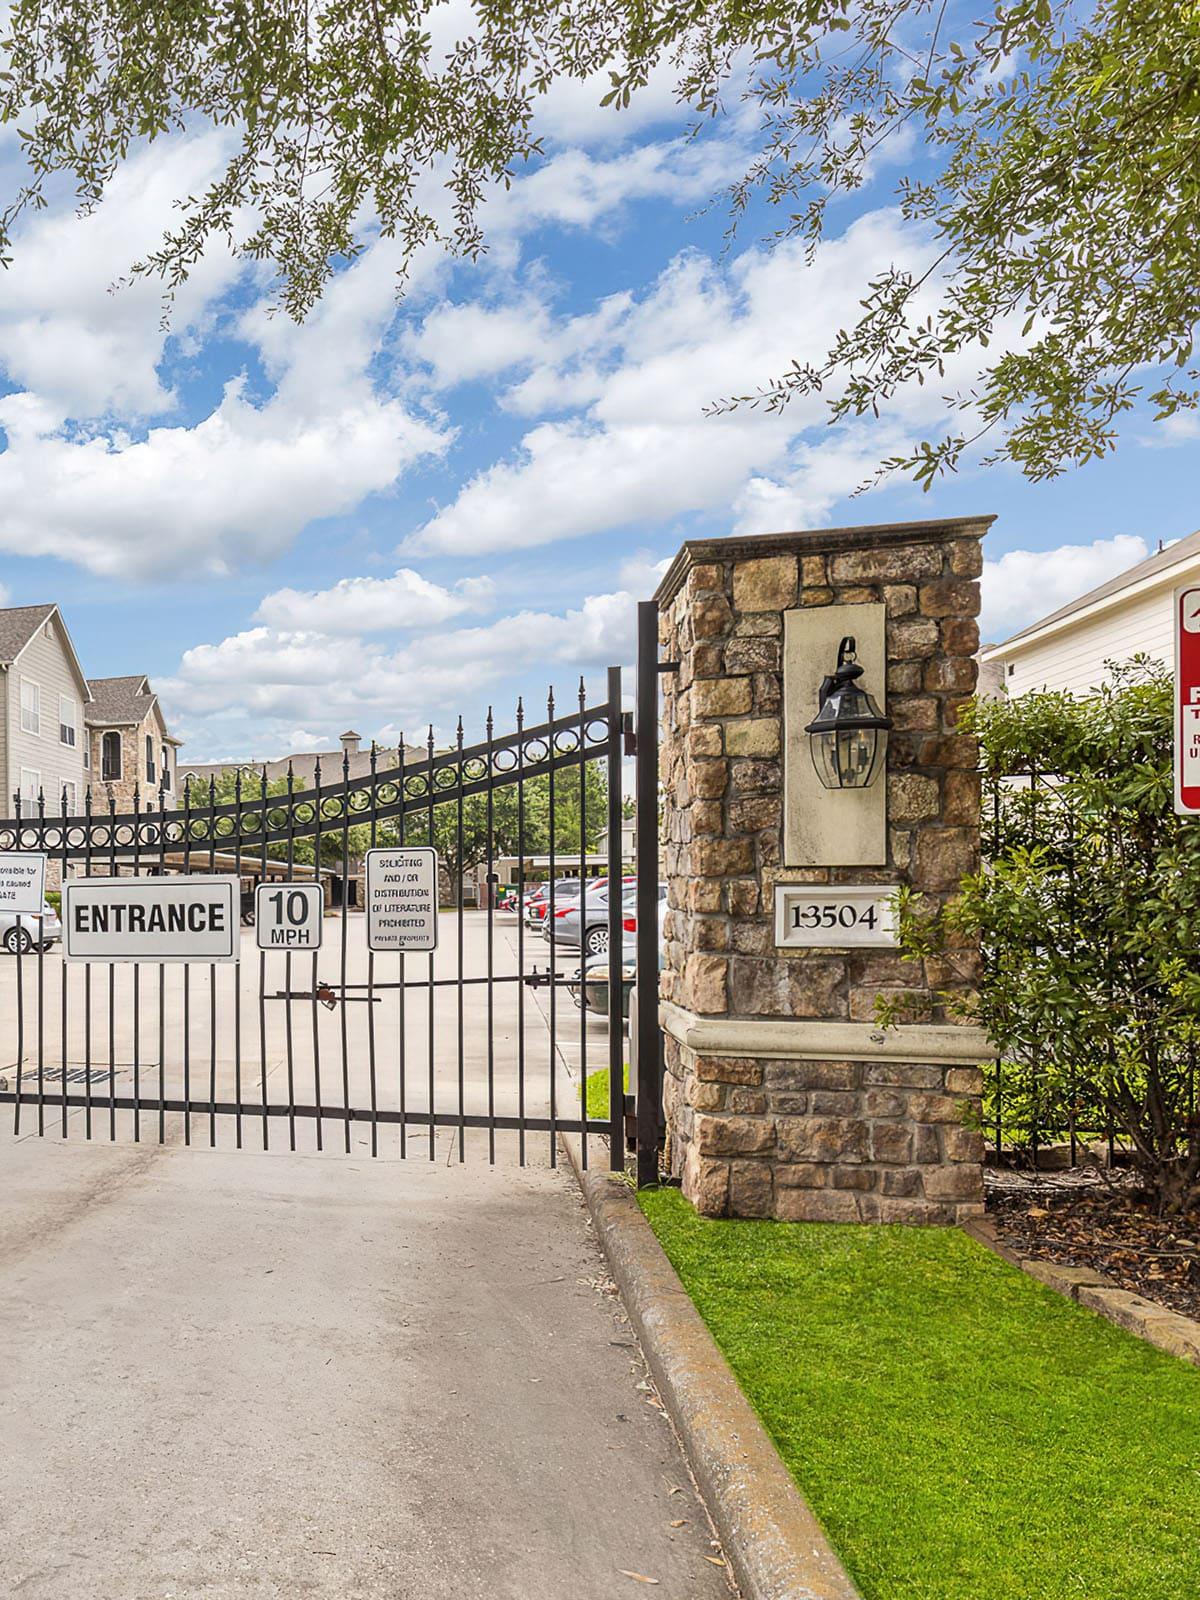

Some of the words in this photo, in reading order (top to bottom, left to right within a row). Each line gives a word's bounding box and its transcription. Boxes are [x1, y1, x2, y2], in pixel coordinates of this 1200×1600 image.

[374, 889, 430, 898] DISTRIBUTION
[75, 903, 225, 933] ENTRANCE
[269, 891, 309, 925] 10
[384, 904, 431, 913] LITERATURE
[791, 904, 878, 930] 13504
[271, 929, 310, 945] MPH
